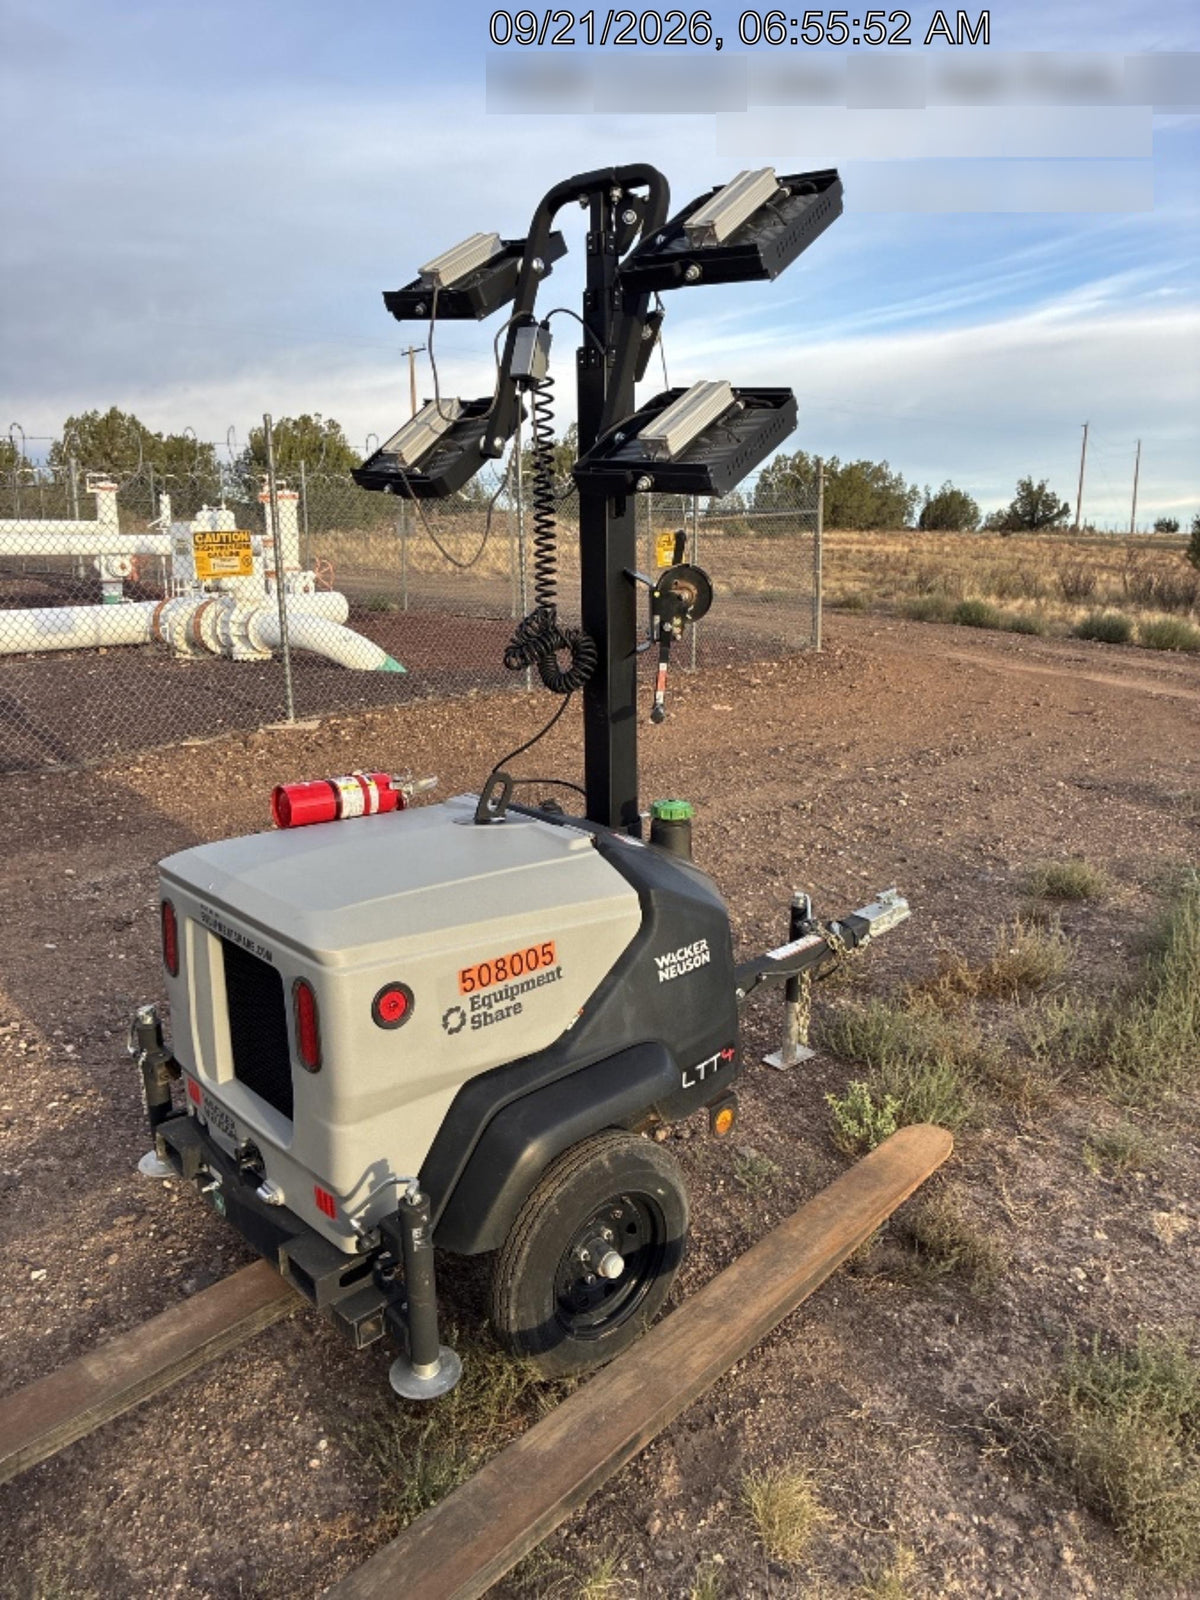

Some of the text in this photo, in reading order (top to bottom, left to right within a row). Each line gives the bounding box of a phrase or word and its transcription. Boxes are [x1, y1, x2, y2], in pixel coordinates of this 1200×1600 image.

[194, 532, 249, 544] CAUTION
[460, 941, 555, 993] 508005
[654, 938, 710, 970] WACKER
[657, 950, 711, 983] NEUSON
[468, 965, 563, 1013] Equipment
[470, 1001, 523, 1031] Share
